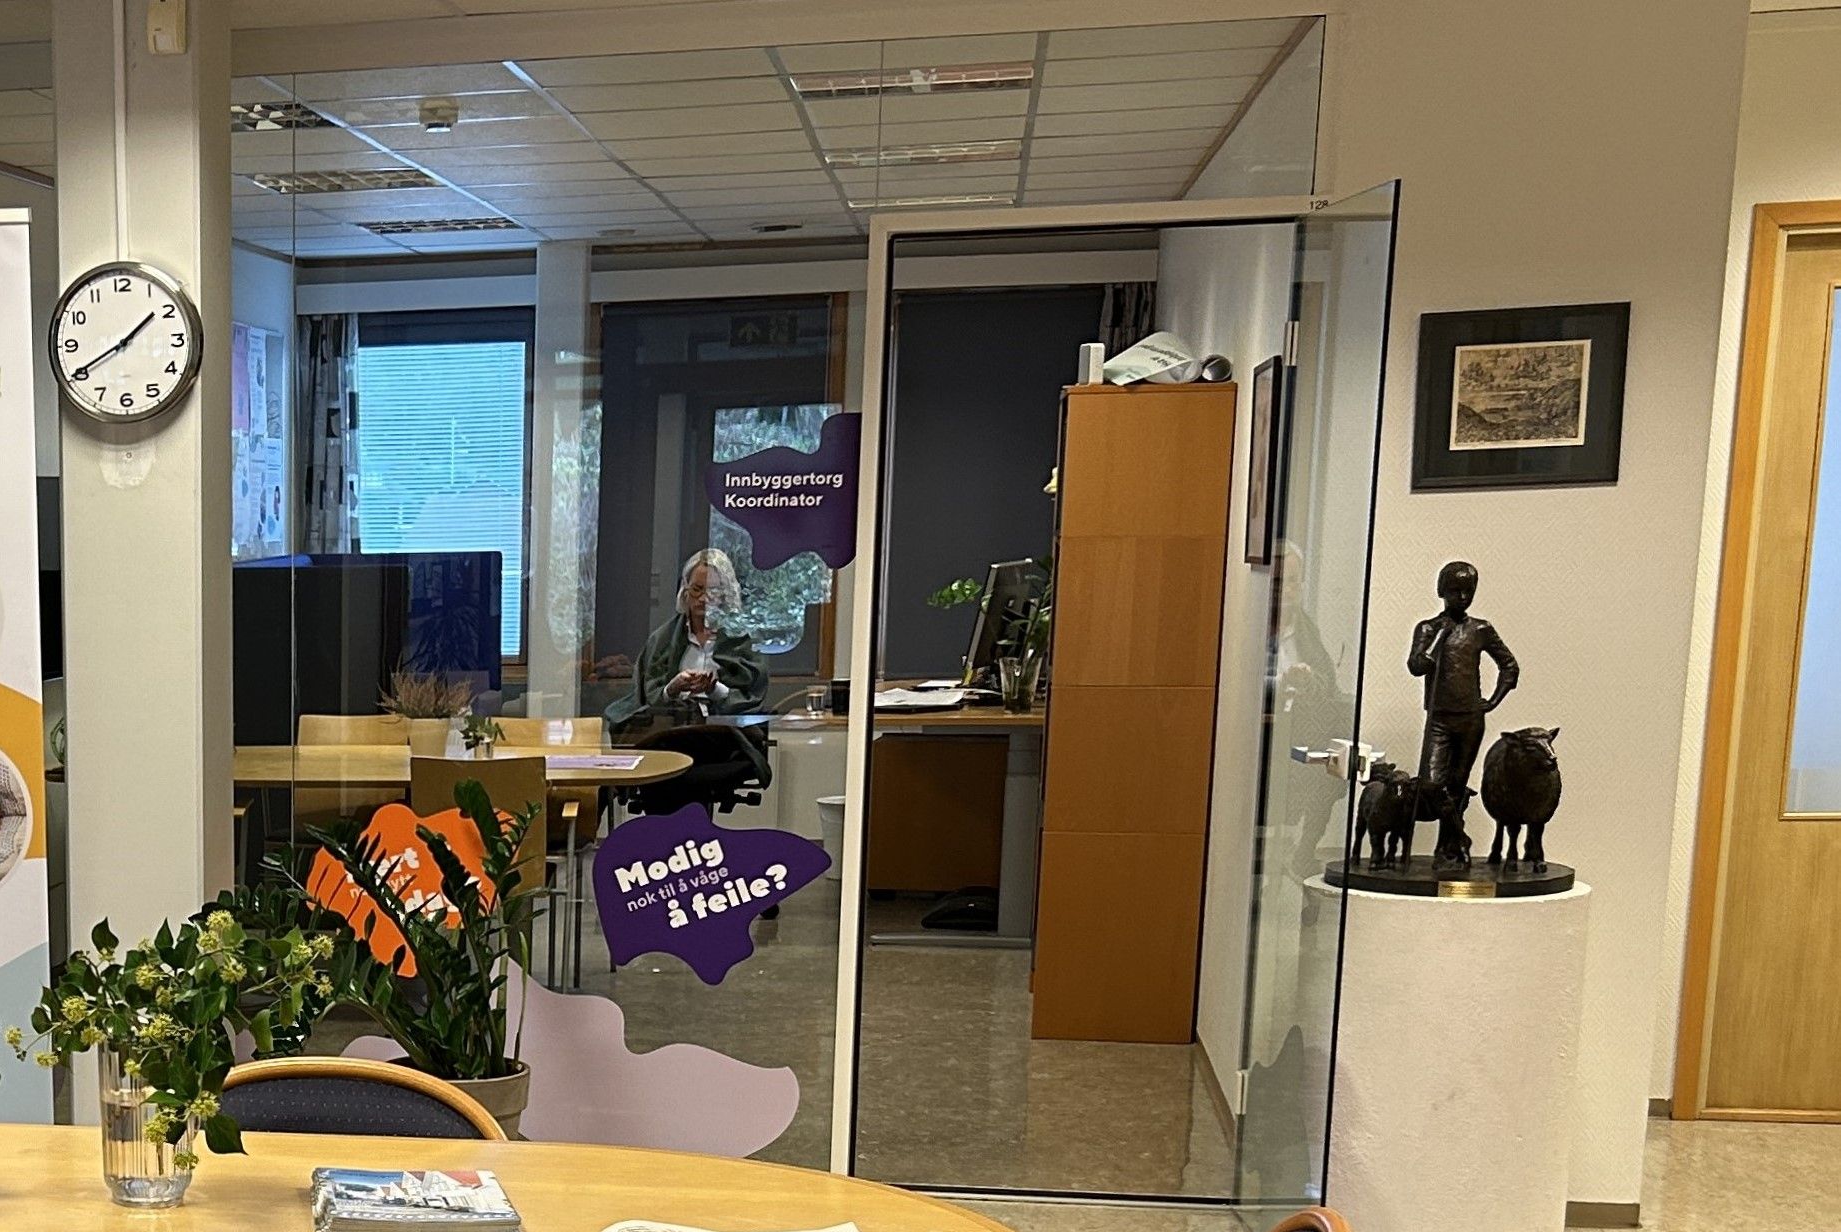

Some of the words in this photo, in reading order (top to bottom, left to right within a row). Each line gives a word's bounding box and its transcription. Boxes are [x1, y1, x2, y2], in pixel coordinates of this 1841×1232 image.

[114, 278, 131, 292] 12
[147, 283, 151, 298] 1
[90, 288, 100, 303] 11
[72, 311, 86, 325] 10
[162, 304, 175, 319] 2
[64, 339, 78, 352] 9
[171, 333, 184, 347] 3
[164, 361, 177, 375] 4
[94, 387, 106, 401] 7
[146, 383, 160, 397] 5
[120, 393, 133, 407] 6
[725, 472, 843, 489] Innbyggertorg
[725, 493, 823, 508] Koordinator
[614, 839, 724, 893] Modig
[627, 891, 658, 912] nok
[658, 883, 676, 900] til
[678, 879, 689, 893] å
[689, 867, 728, 888] våge
[668, 899, 689, 928] å
[692, 864, 787, 919] feile?
